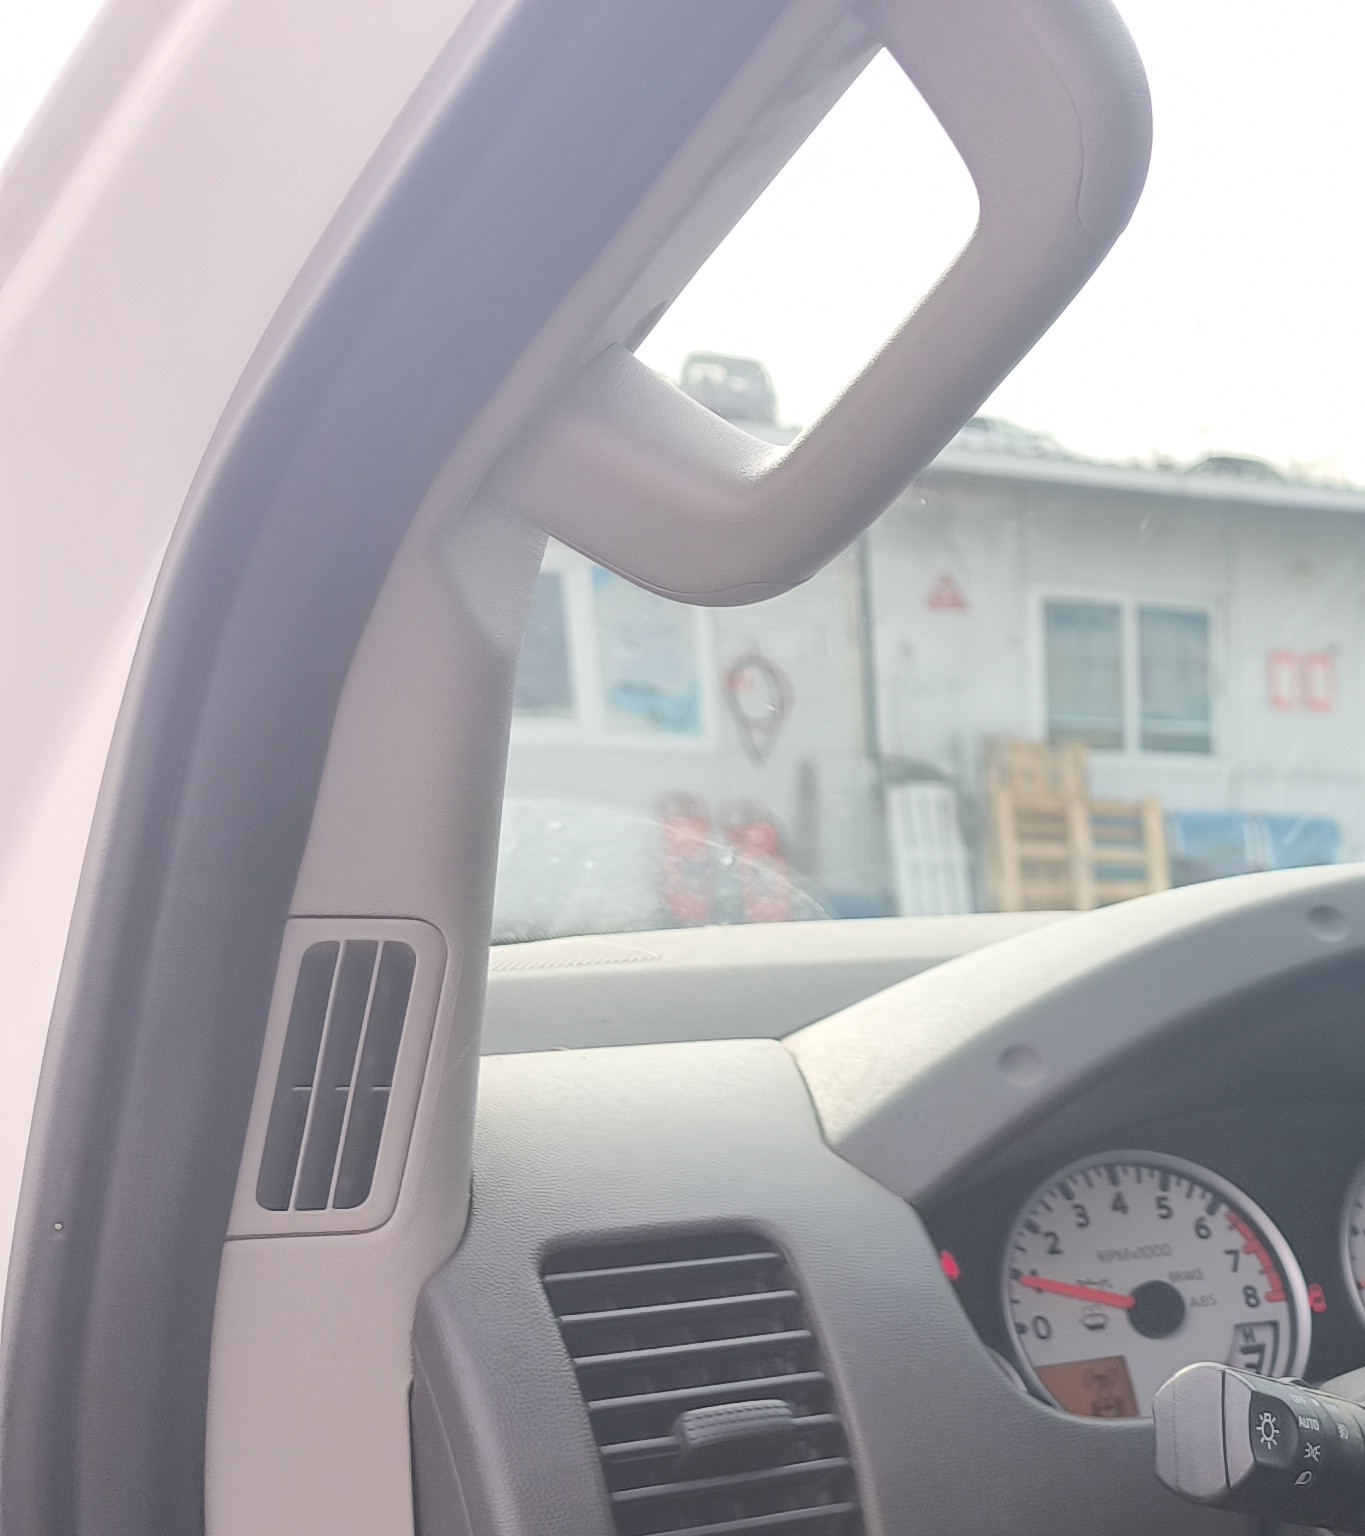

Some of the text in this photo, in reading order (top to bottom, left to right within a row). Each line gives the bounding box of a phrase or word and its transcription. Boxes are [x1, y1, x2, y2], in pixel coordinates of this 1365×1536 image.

[1111, 1190, 1129, 1214] 4
[1156, 1197, 1173, 1219] 5
[1072, 1204, 1090, 1228] 3
[1195, 1216, 1212, 1239] 6
[1044, 1231, 1063, 1255] 2
[1224, 1249, 1240, 1273] 7
[1243, 1285, 1260, 1308] 8
[1033, 1315, 1051, 1340] 0
[1298, 1415, 1320, 1432] AUTO
